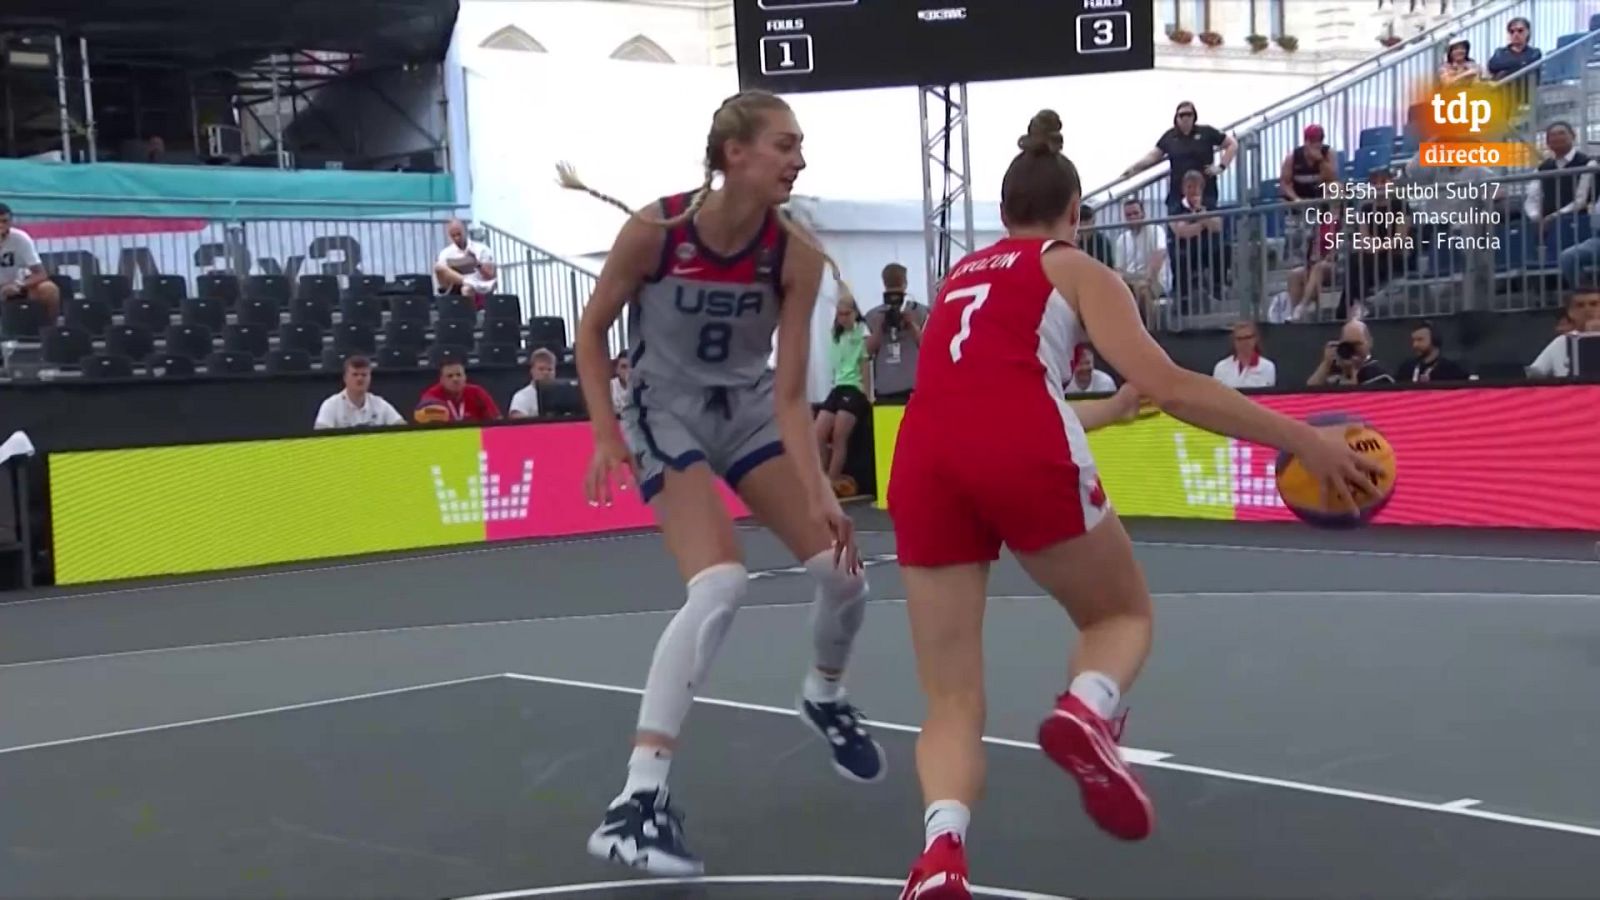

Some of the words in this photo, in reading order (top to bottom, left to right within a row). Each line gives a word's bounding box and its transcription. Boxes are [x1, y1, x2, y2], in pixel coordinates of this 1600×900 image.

[766, 18, 804, 31] FOULS
[1093, 19, 1113, 45] 3
[779, 42, 795, 67] 1
[675, 285, 763, 318] USA
[944, 283, 992, 364] 7
[697, 322, 733, 363] 8
